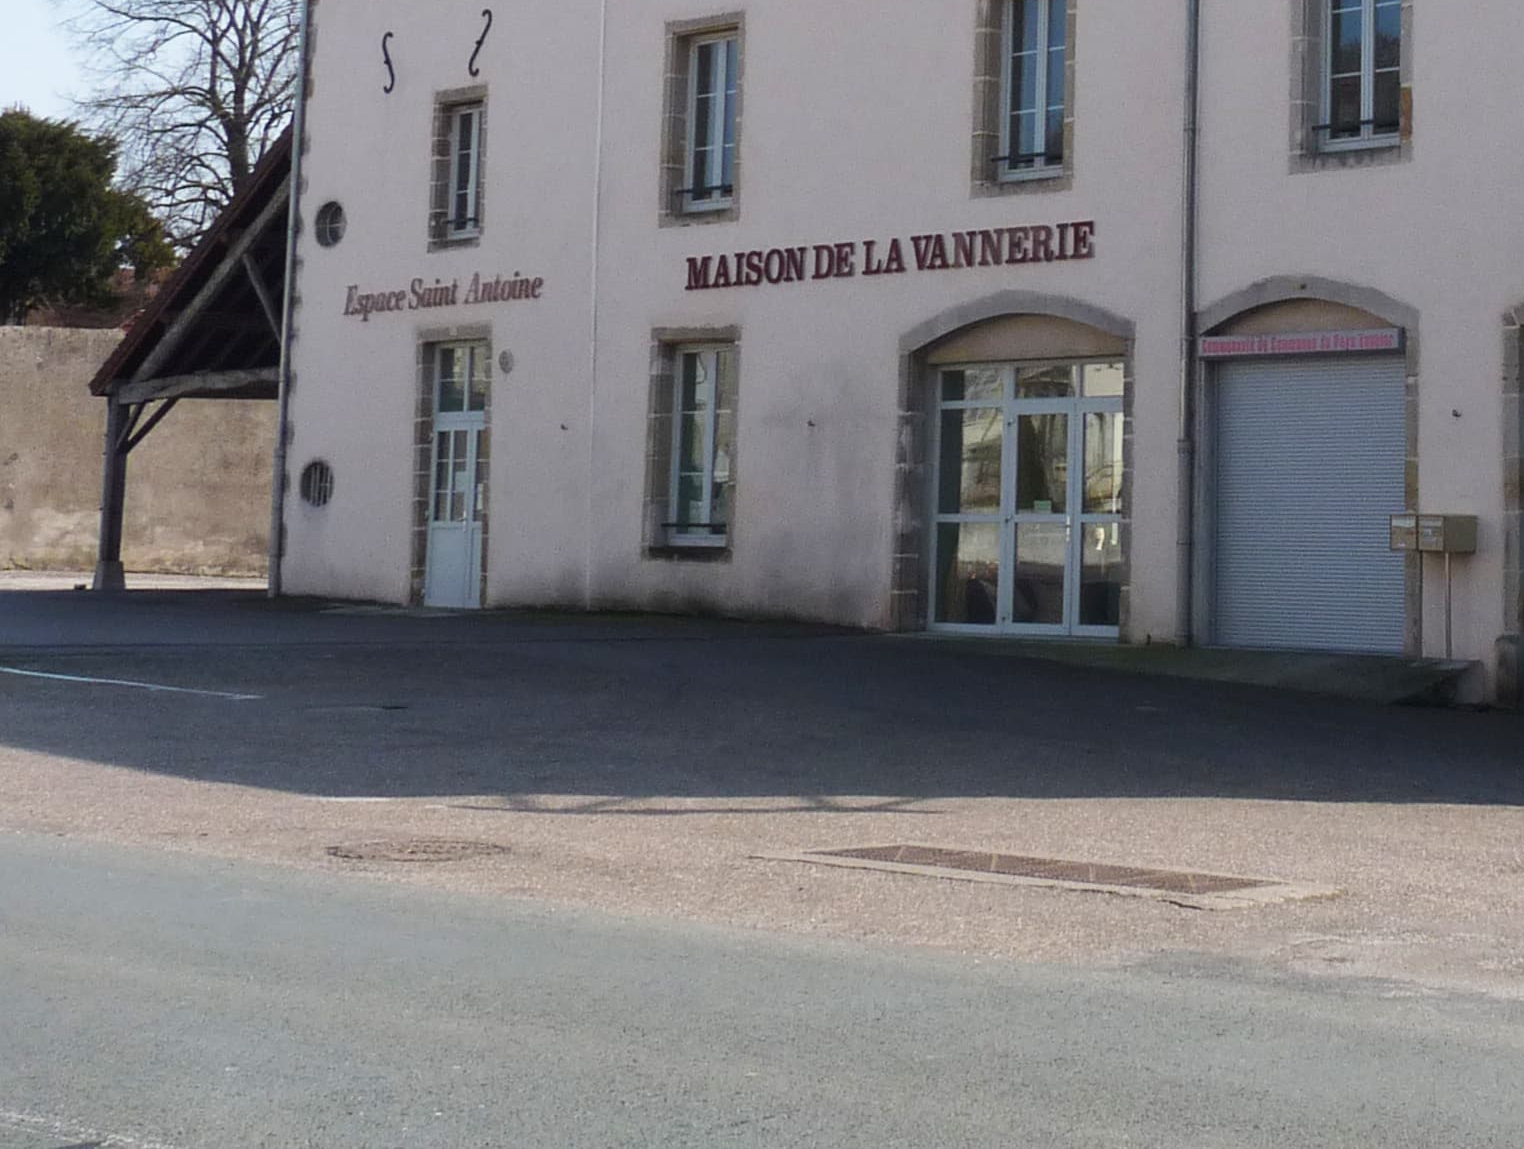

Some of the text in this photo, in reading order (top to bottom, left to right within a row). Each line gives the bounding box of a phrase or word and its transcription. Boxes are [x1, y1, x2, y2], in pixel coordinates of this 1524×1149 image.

[684, 220, 1096, 291] MAISON DE LA VANNERIE
[343, 270, 545, 322] Espace Saint Antoine
